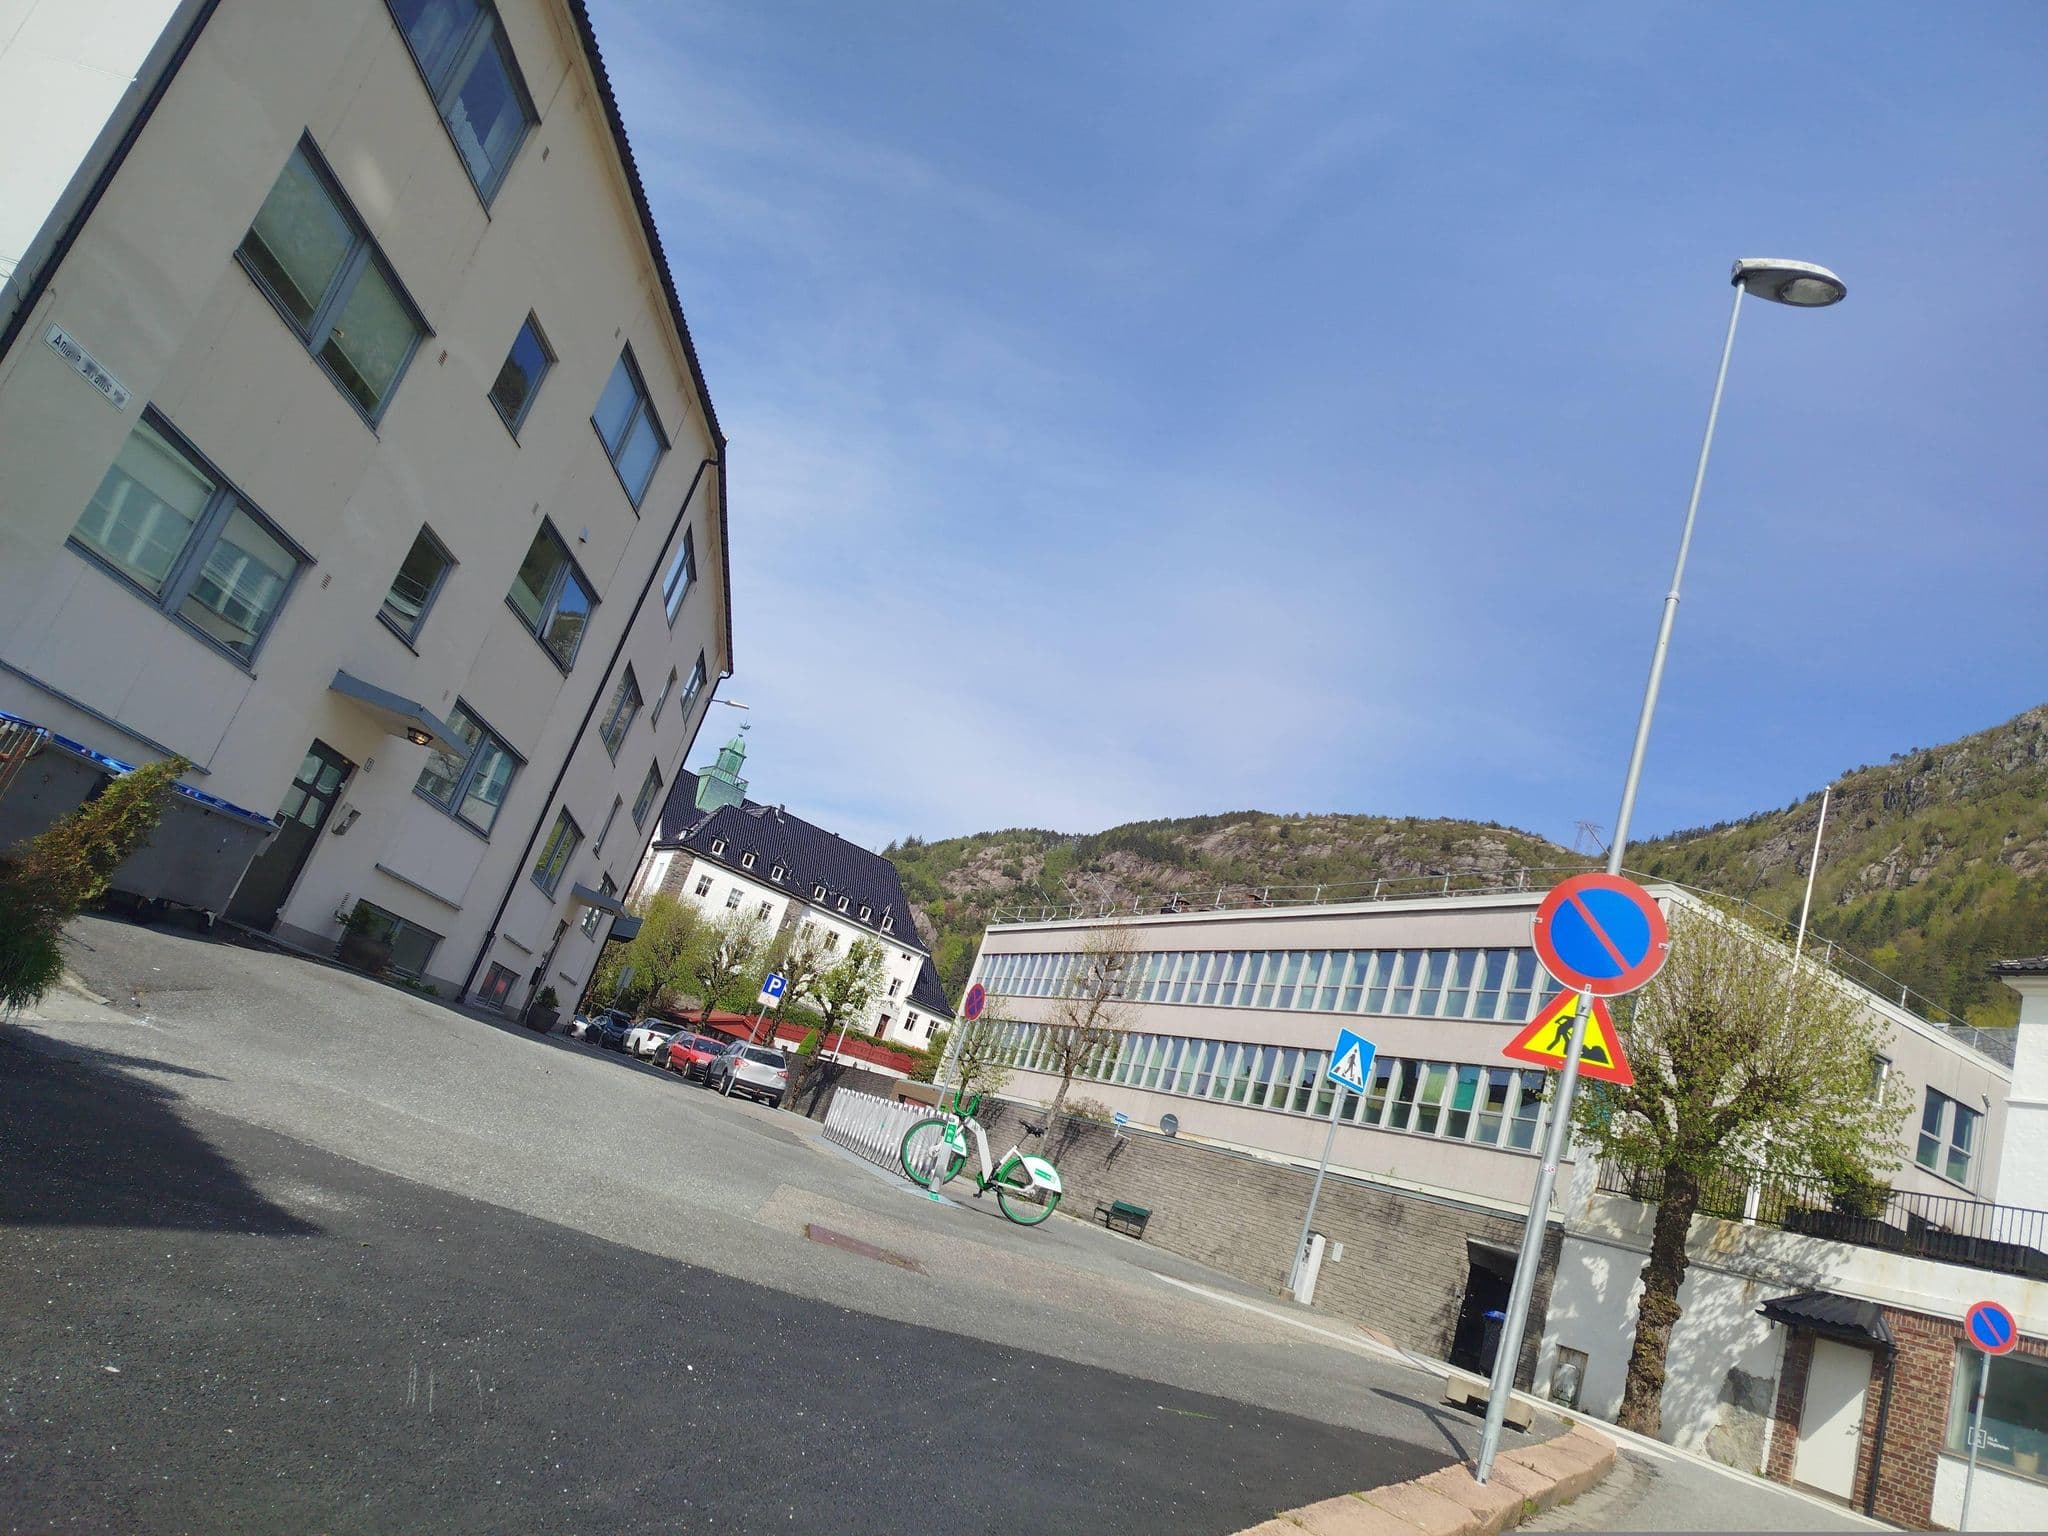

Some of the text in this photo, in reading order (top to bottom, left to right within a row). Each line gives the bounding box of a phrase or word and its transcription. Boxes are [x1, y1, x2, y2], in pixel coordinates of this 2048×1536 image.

[52, 334, 112, 393] Amae rams
[768, 976, 782, 993] P
